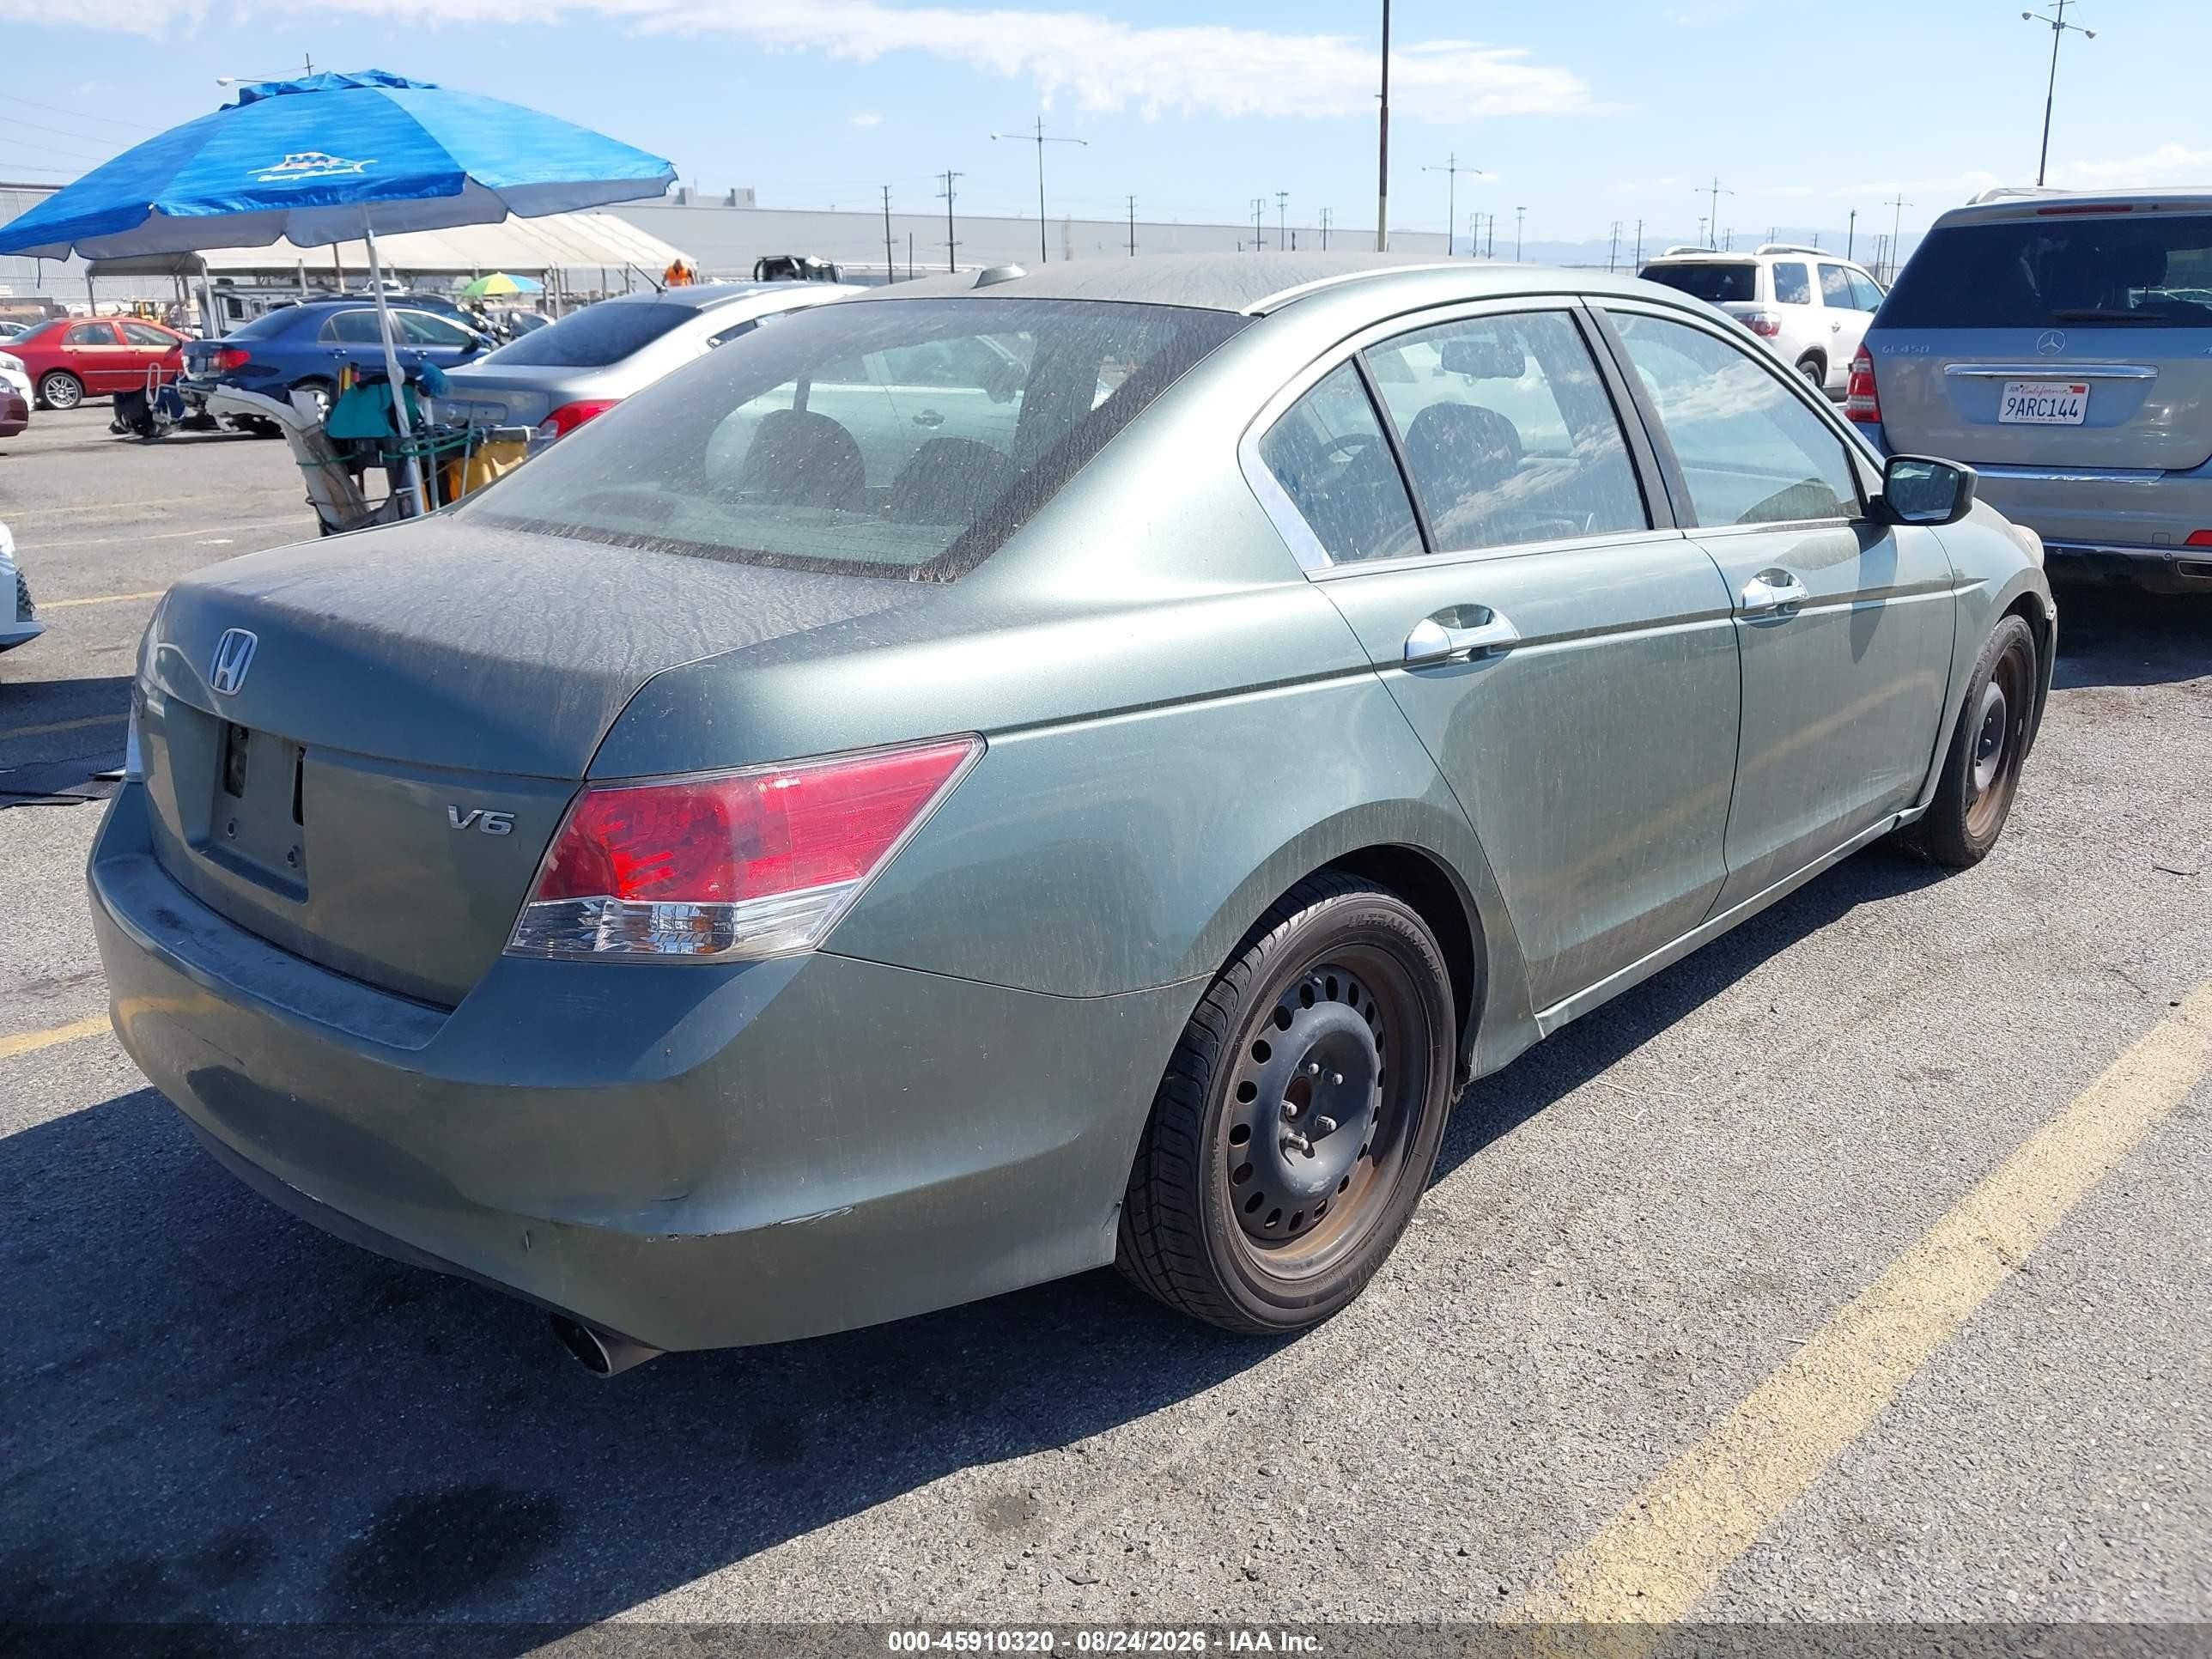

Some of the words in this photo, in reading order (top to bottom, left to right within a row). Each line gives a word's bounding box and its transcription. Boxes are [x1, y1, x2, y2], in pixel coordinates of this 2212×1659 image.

[1881, 344, 1896, 354] GL
[1899, 344, 1931, 354] 450
[2004, 398, 2079, 418] 9ARC144
[447, 805, 515, 836] V6
